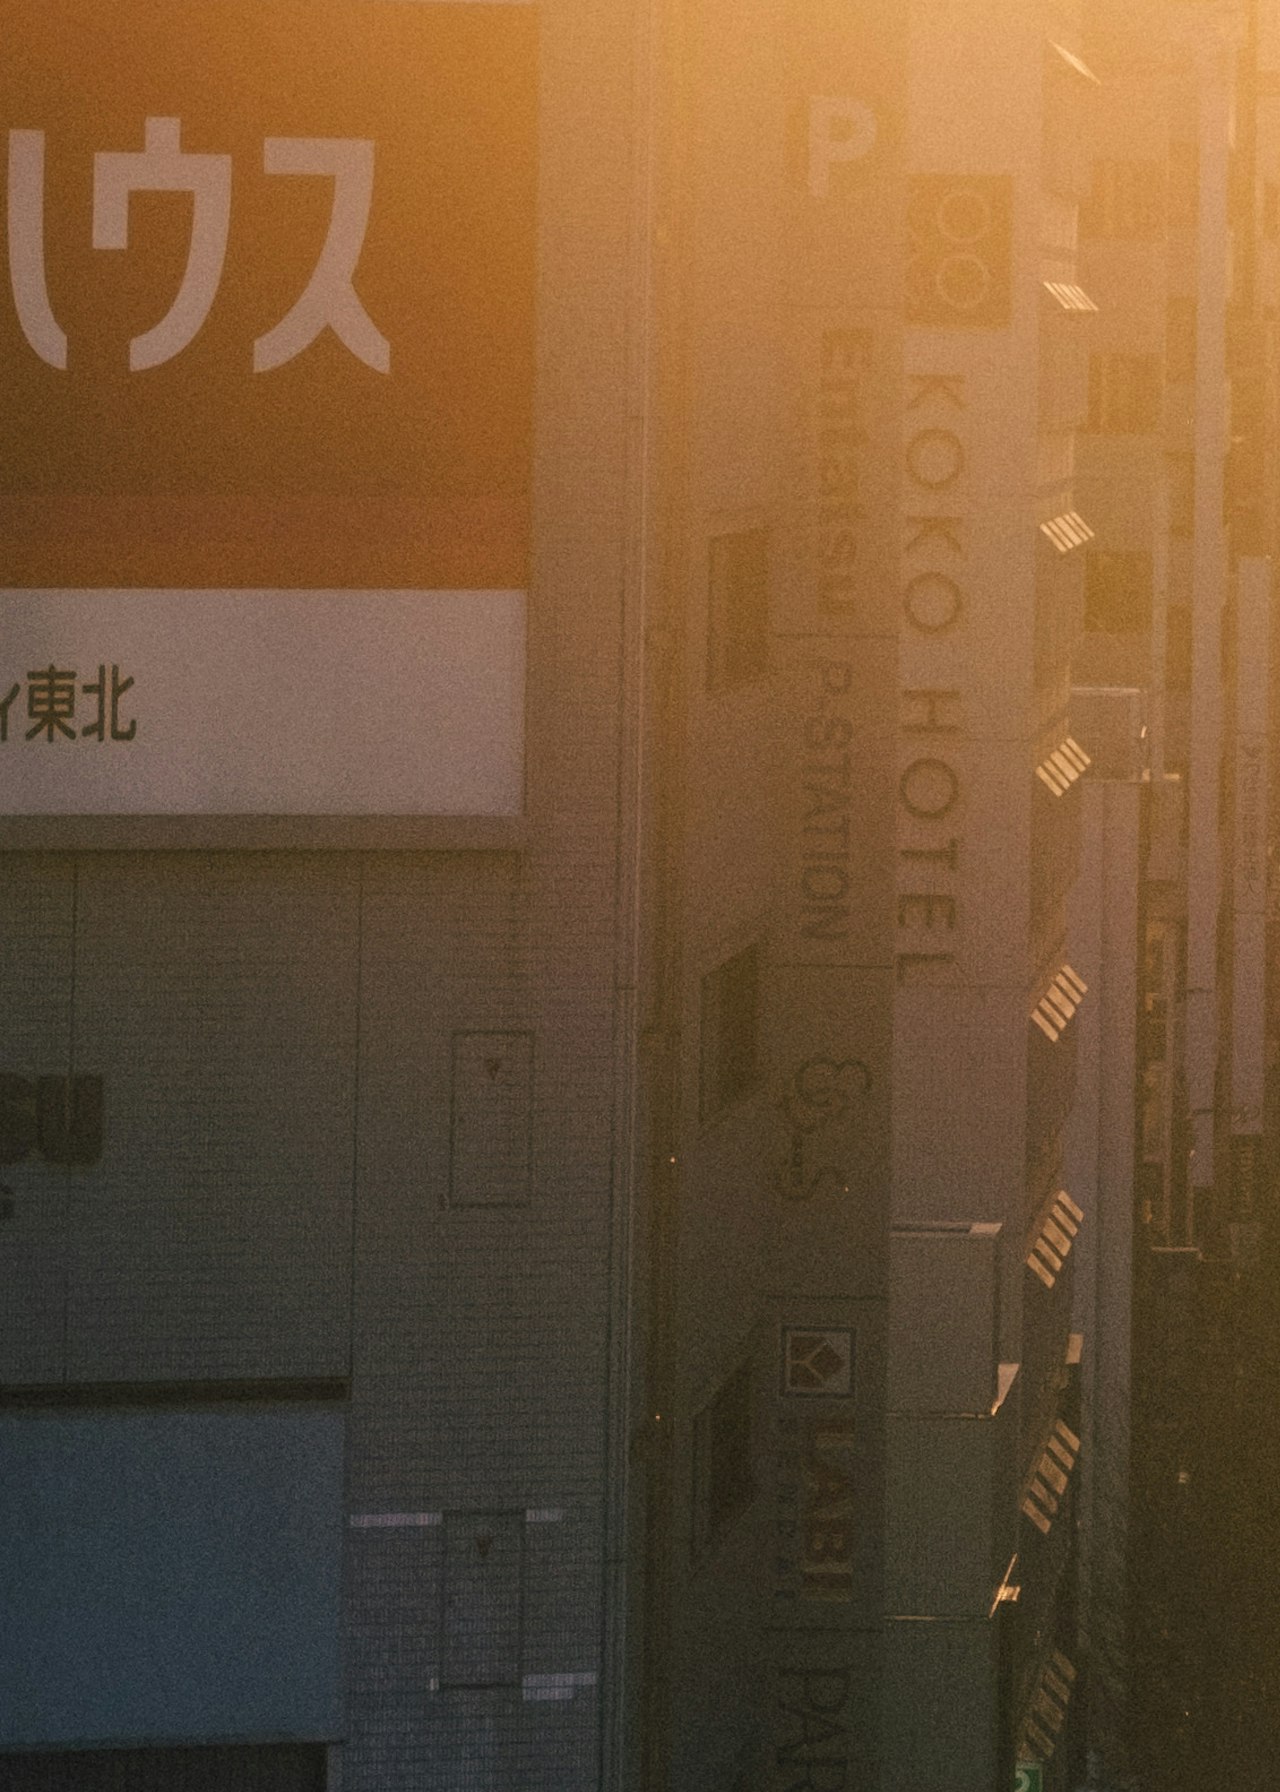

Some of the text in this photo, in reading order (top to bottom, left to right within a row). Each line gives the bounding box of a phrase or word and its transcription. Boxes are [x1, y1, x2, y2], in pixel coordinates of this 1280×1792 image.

[808, 97, 877, 197] P
[897, 372, 966, 985] KOKO HOTEL
[805, 1416, 857, 1591] LABI
